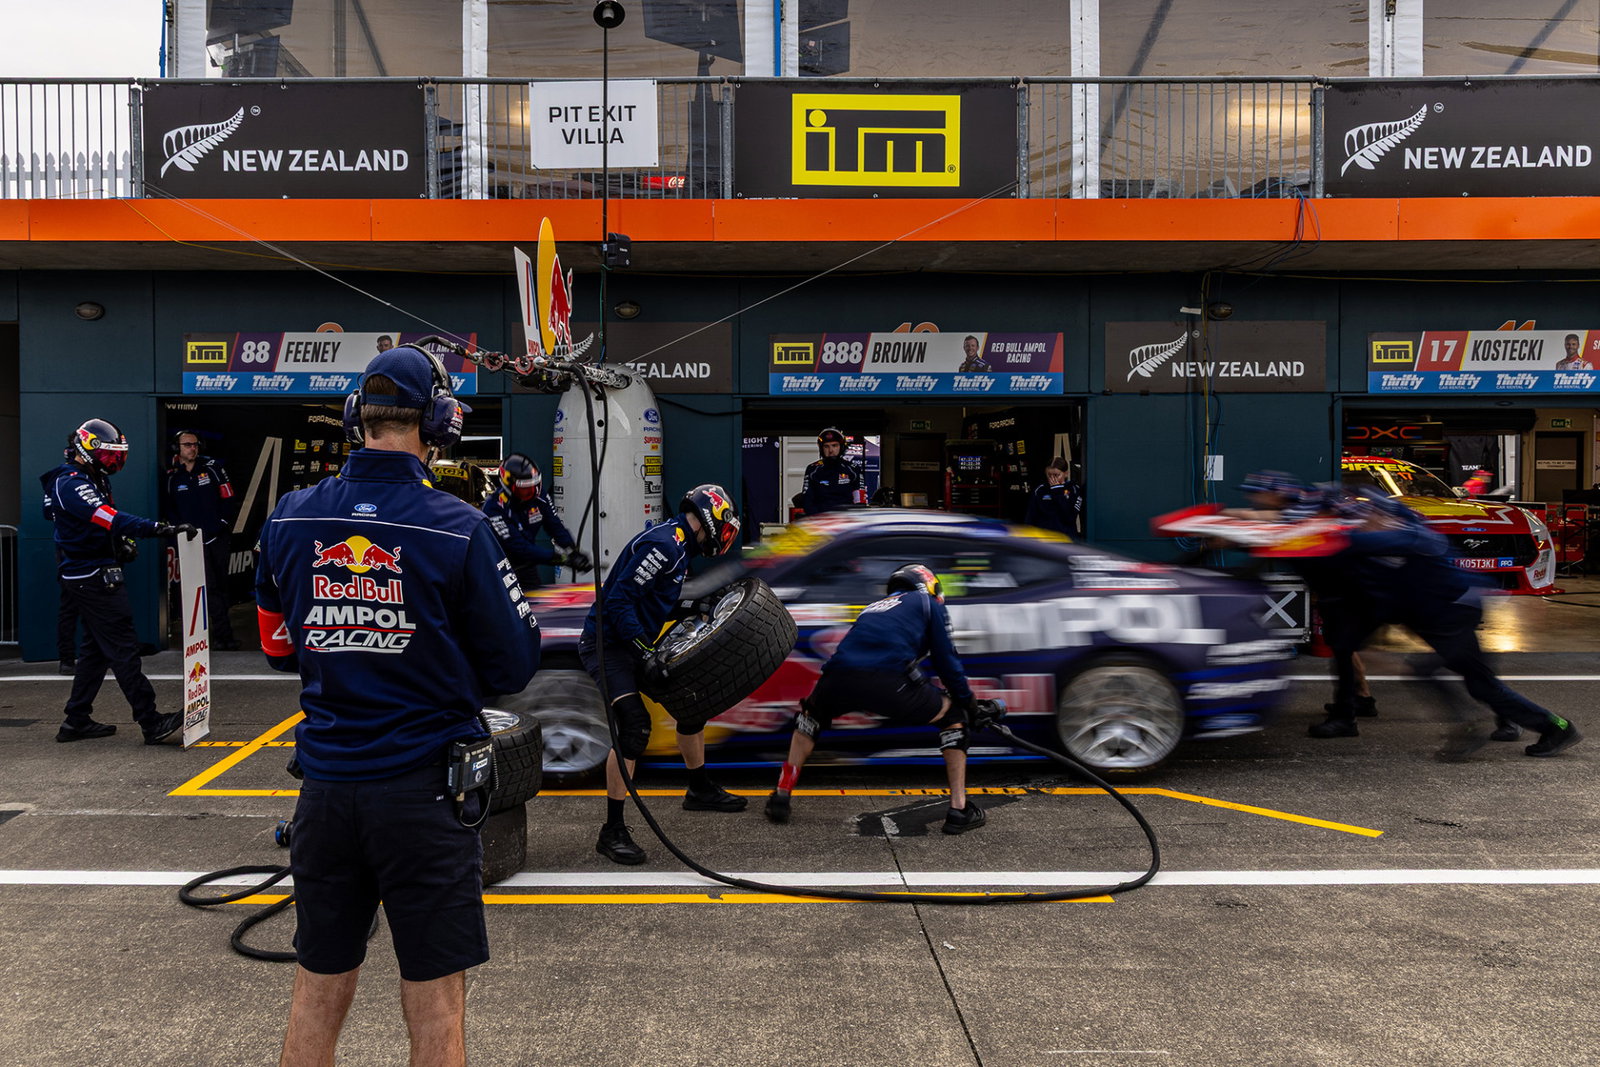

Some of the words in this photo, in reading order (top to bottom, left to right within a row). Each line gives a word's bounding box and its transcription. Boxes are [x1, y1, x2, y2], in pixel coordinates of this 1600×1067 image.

[549, 106, 582, 122] PIT
[588, 105, 636, 122] EXIT
[562, 128, 624, 144] VILLA
[224, 150, 284, 172] NEW
[289, 150, 409, 171] ZEALAND
[1404, 146, 1466, 169] NEW
[1471, 145, 1592, 168] ZEALAND
[241, 341, 271, 364] 88
[284, 341, 342, 363] FEENEY
[822, 342, 863, 364] 888
[871, 342, 928, 364] BROWN
[990, 343, 1004, 352] RED
[1006, 343, 1022, 352] BULL
[1023, 343, 1046, 352] AMPOL
[1430, 340, 1458, 362] 17
[1471, 339, 1544, 362] KOSTECKI
[1006, 353, 1032, 363] RACING
[1172, 362, 1214, 377] NEW
[1219, 361, 1304, 377] ZEALAND
[196, 375, 238, 390] Thrifty
[252, 375, 295, 390] Thrifty
[309, 375, 352, 390] Thrifty
[783, 376, 825, 391] Thrifty
[840, 376, 882, 391] Thrifty
[896, 376, 938, 391] Thrifty
[953, 376, 995, 391] Thrifty
[1010, 376, 1052, 391] Thrifty
[1382, 374, 1424, 390] Thrifty
[1439, 374, 1481, 390] Thrifty
[1496, 374, 1538, 390] Thrifty
[1554, 374, 1596, 390] Thrifty
[76, 444, 94, 464] AMPOL
[702, 508, 716, 538] AMPOL
[313, 574, 360, 600] Red
[361, 575, 404, 604] Bull
[304, 606, 416, 630] AMPOL
[272, 620, 292, 644] 4
[305, 630, 415, 648] RACING
[185, 640, 208, 658] AMPOL
[188, 684, 197, 701] Red
[198, 680, 208, 696] Bull
[186, 696, 209, 716] AMPOL
[185, 708, 208, 728] RACING
